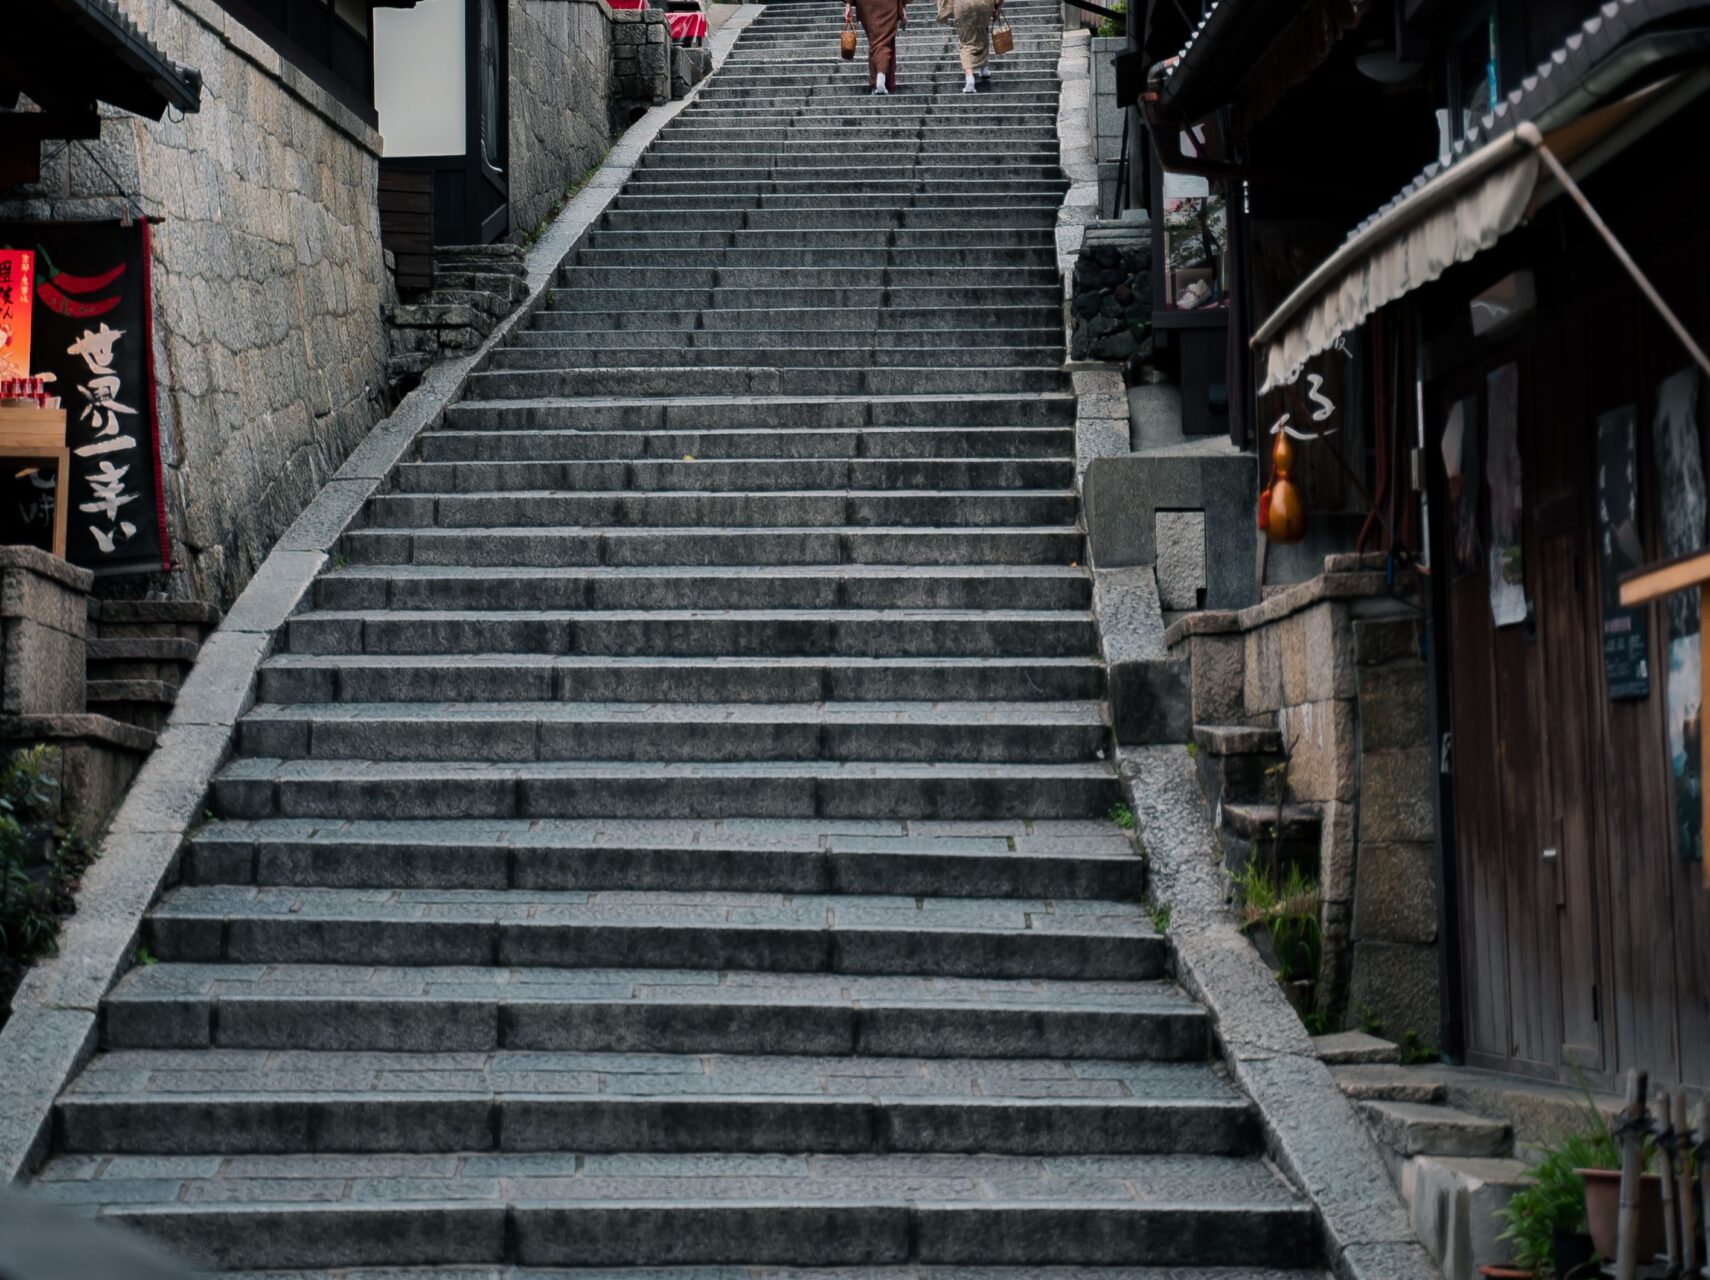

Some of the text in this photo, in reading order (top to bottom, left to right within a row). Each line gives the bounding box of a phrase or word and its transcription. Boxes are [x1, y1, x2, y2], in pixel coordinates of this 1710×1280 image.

[67, 322, 140, 553] 世界一辛い
